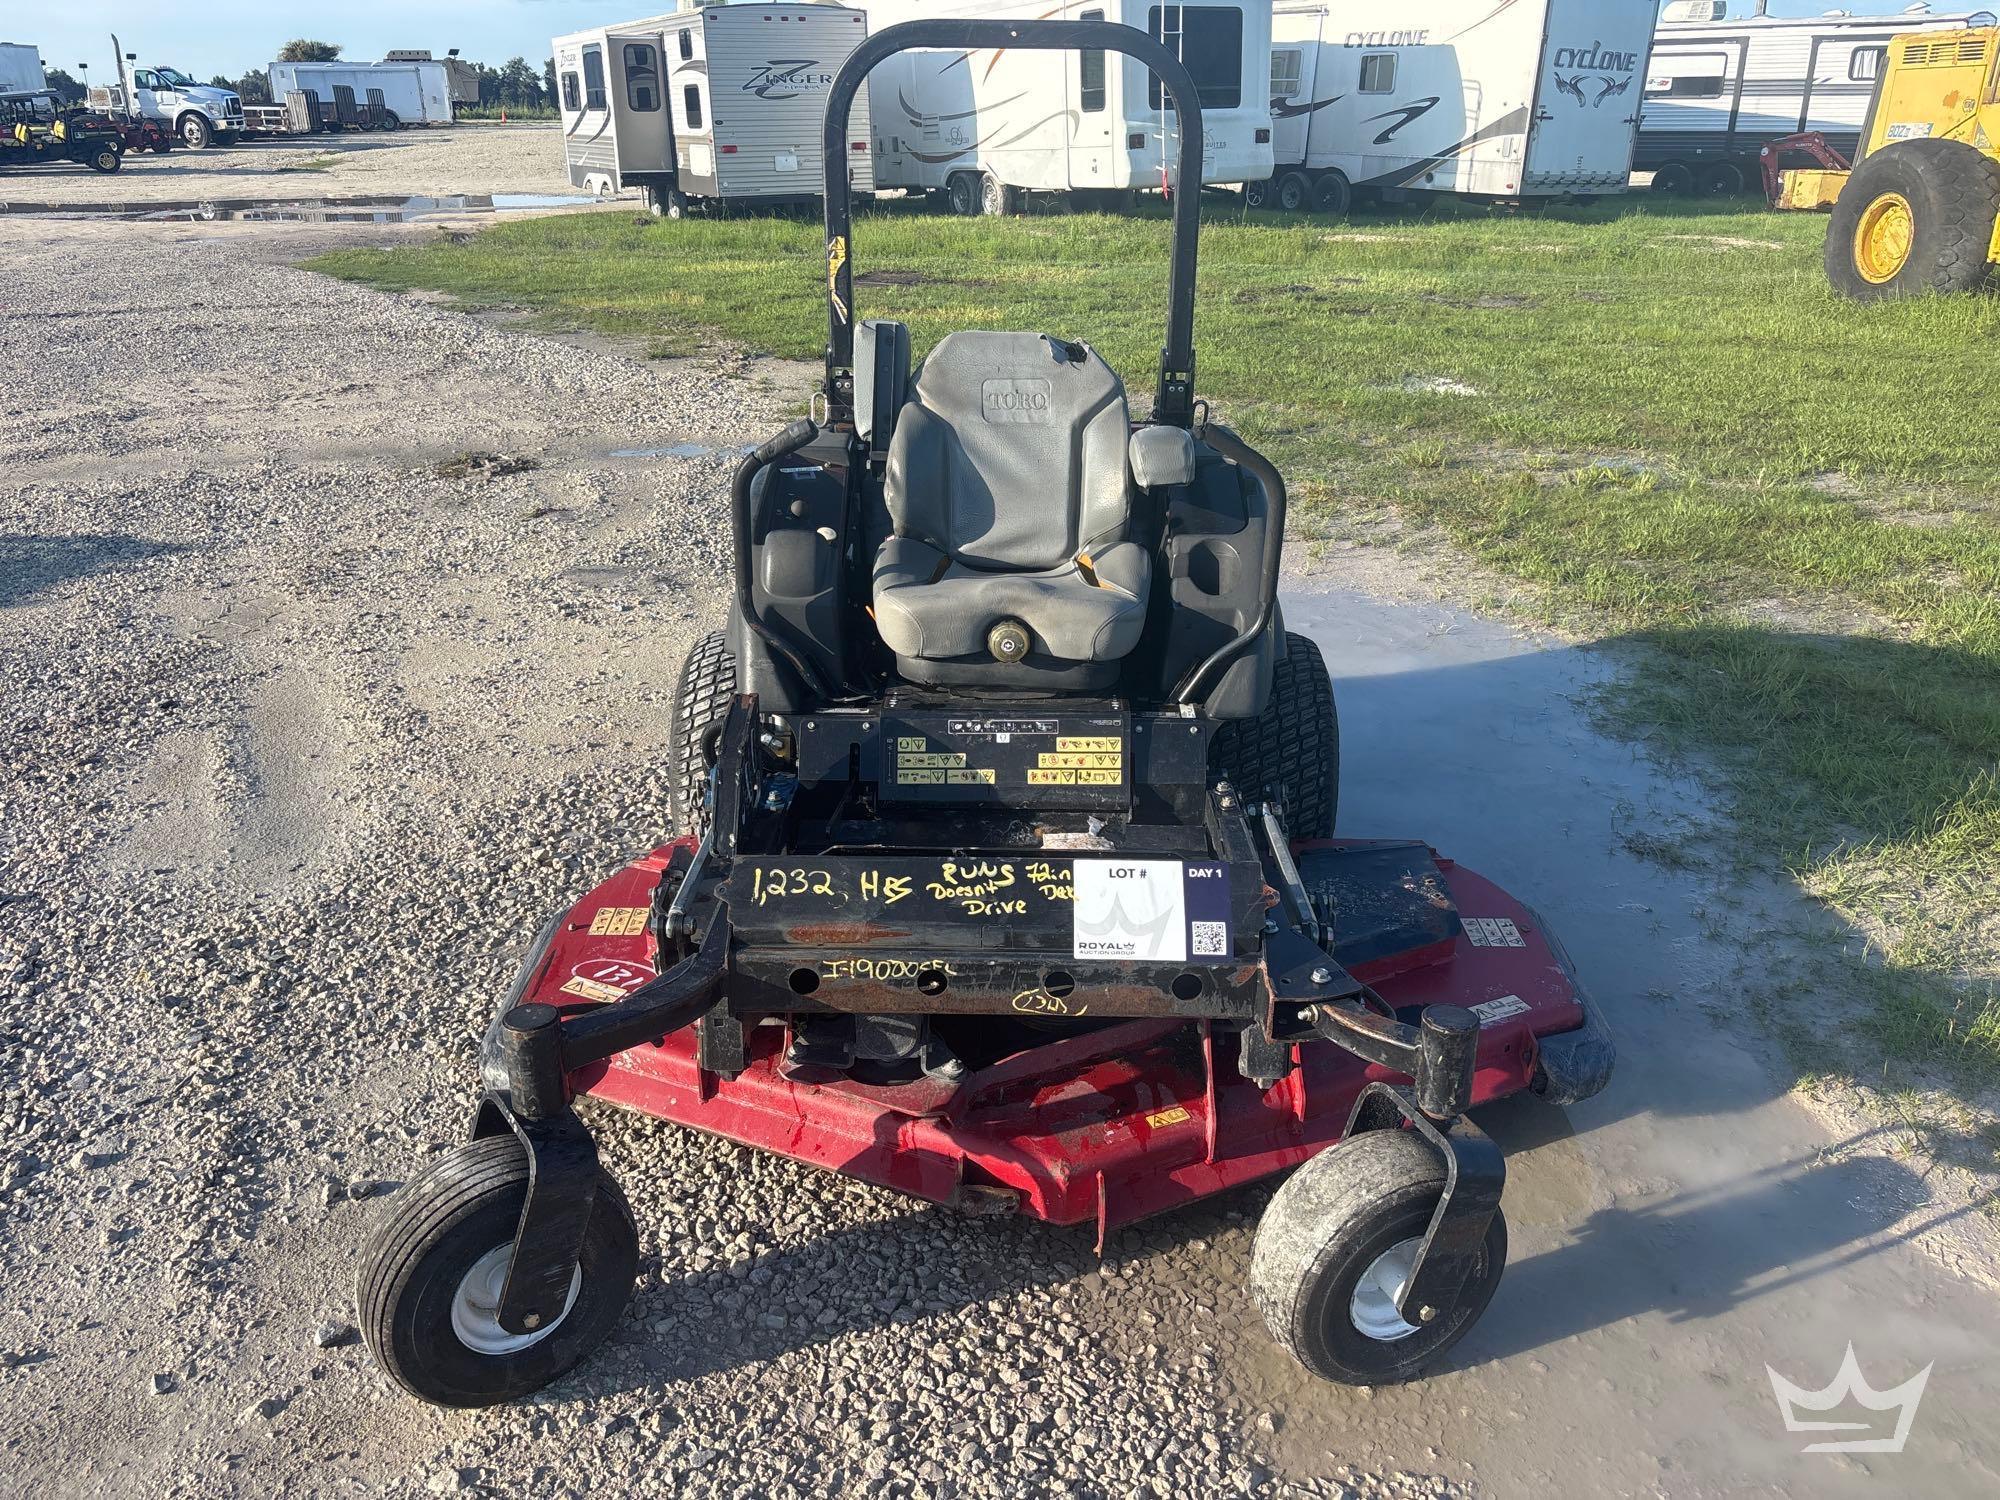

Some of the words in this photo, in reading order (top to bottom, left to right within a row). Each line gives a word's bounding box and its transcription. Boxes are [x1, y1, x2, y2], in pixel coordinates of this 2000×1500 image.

[1344, 30, 1429, 48] CYCLONE
[1554, 40, 1637, 71] CYCLONE
[742, 65, 833, 92] ZINGER
[988, 393, 1047, 410] TORO
[1109, 868, 1135, 878] LOT
[1139, 868, 1147, 878] #
[1189, 869, 1213, 877] DAY
[1216, 869, 1222, 877] 1
